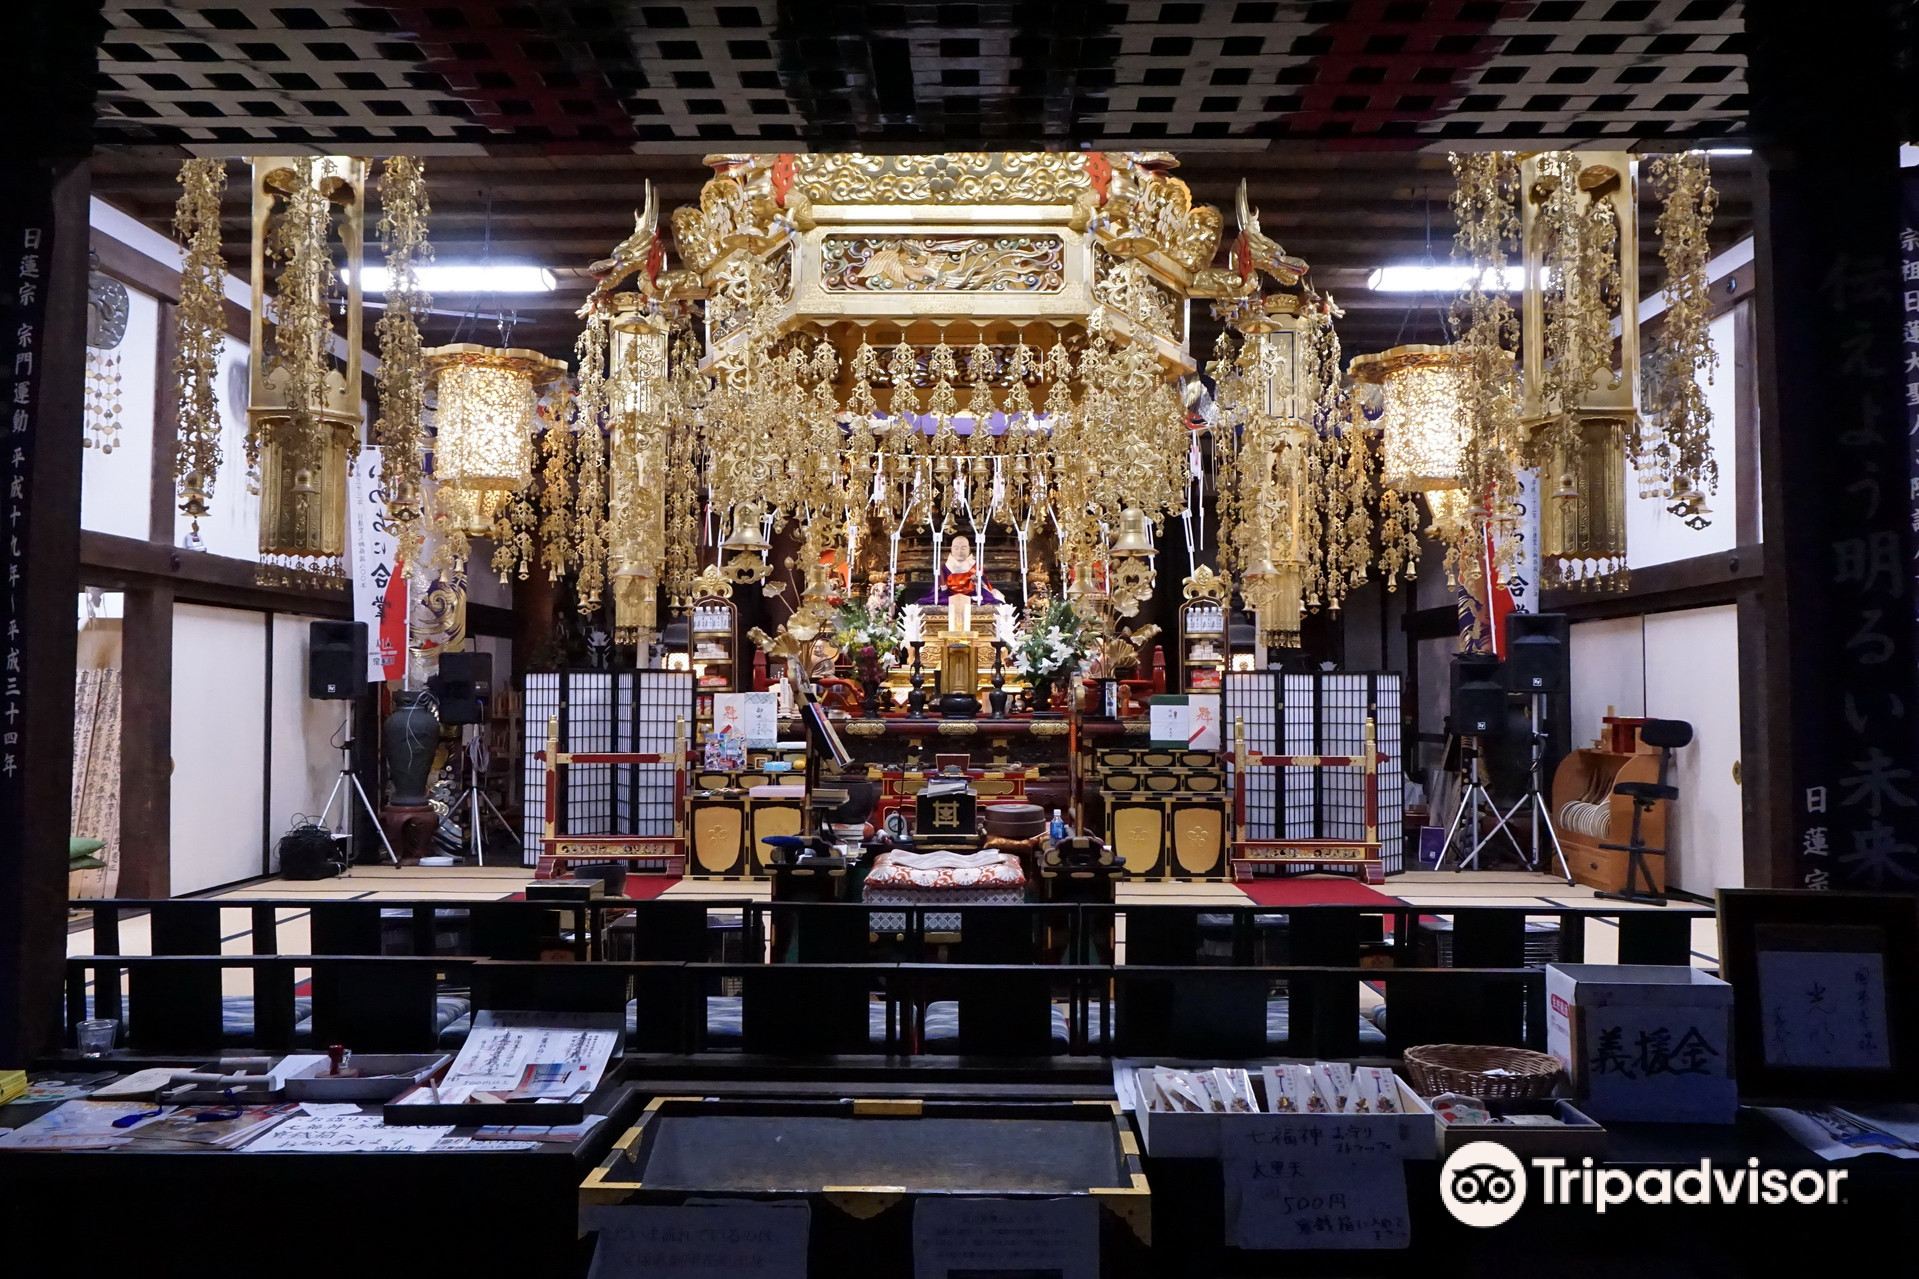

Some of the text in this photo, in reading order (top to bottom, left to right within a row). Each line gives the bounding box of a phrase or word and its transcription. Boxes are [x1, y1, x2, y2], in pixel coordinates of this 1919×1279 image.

[18, 228, 42, 306] 日蓮宗
[12, 323, 33, 432] 宗門運動
[1803, 786, 1830, 890] 日蓮宗
[1593, 1027, 1718, 1078] 義援金
[1245, 1125, 1322, 1146] 七福神
[1283, 1193, 1347, 1214] 500円
